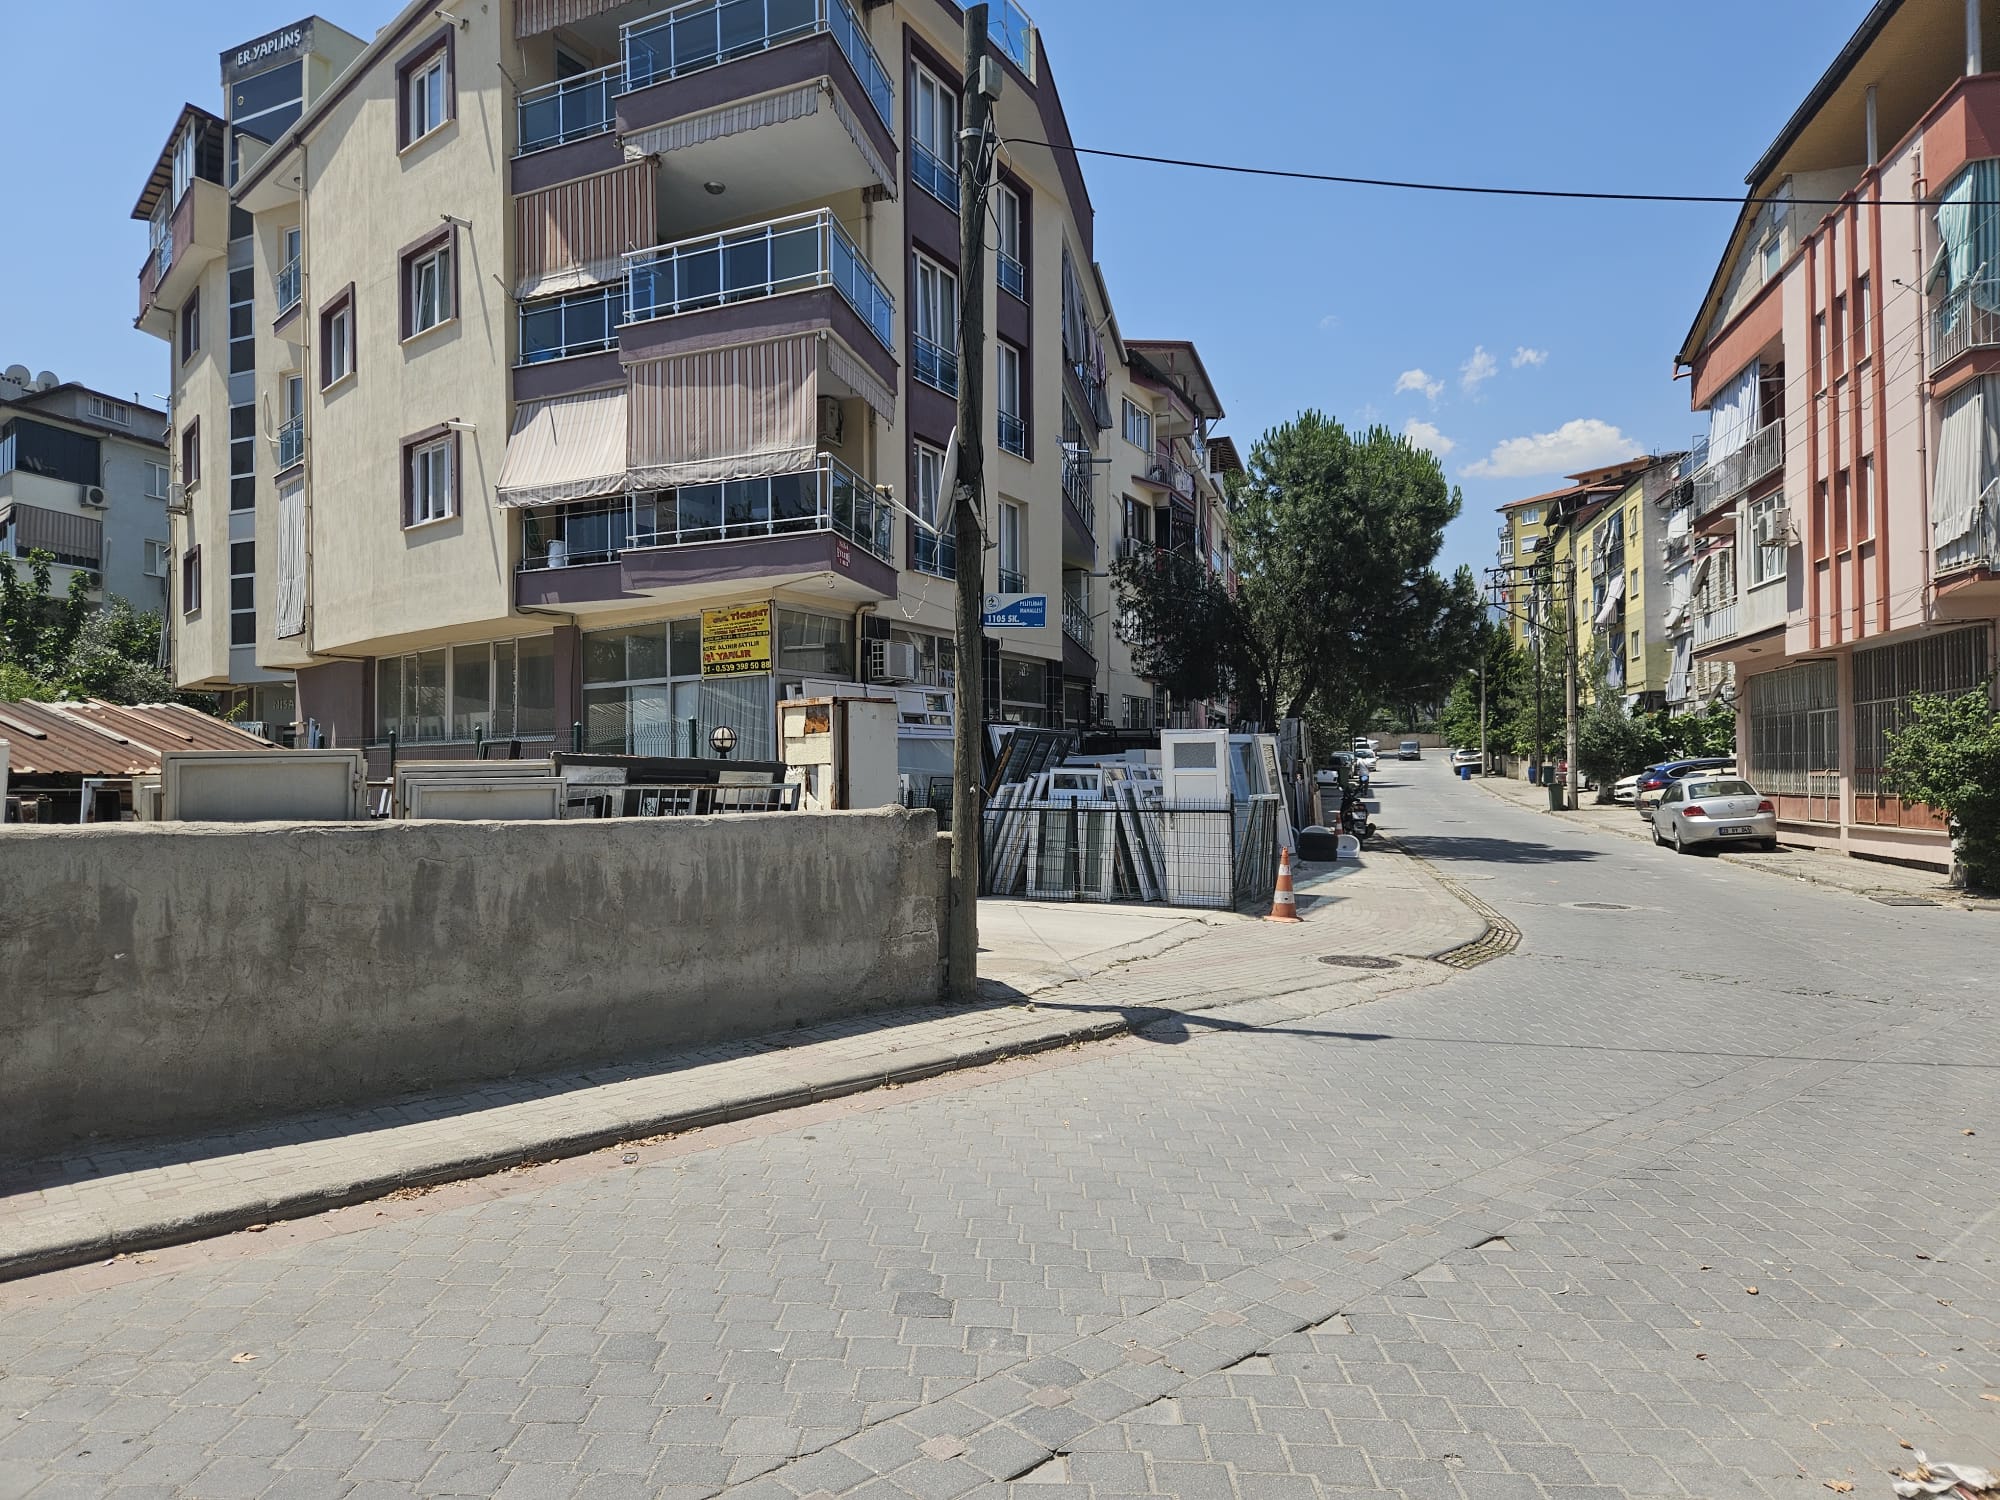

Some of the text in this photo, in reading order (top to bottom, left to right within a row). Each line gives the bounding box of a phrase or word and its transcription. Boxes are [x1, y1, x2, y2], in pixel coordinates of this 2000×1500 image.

[237, 50, 250, 66] ER
[253, 38, 278, 60] YAPI
[988, 614, 1020, 623] 1105 SK.
[716, 649, 752, 661] YAPILIR
[750, 662, 759, 670] 50
